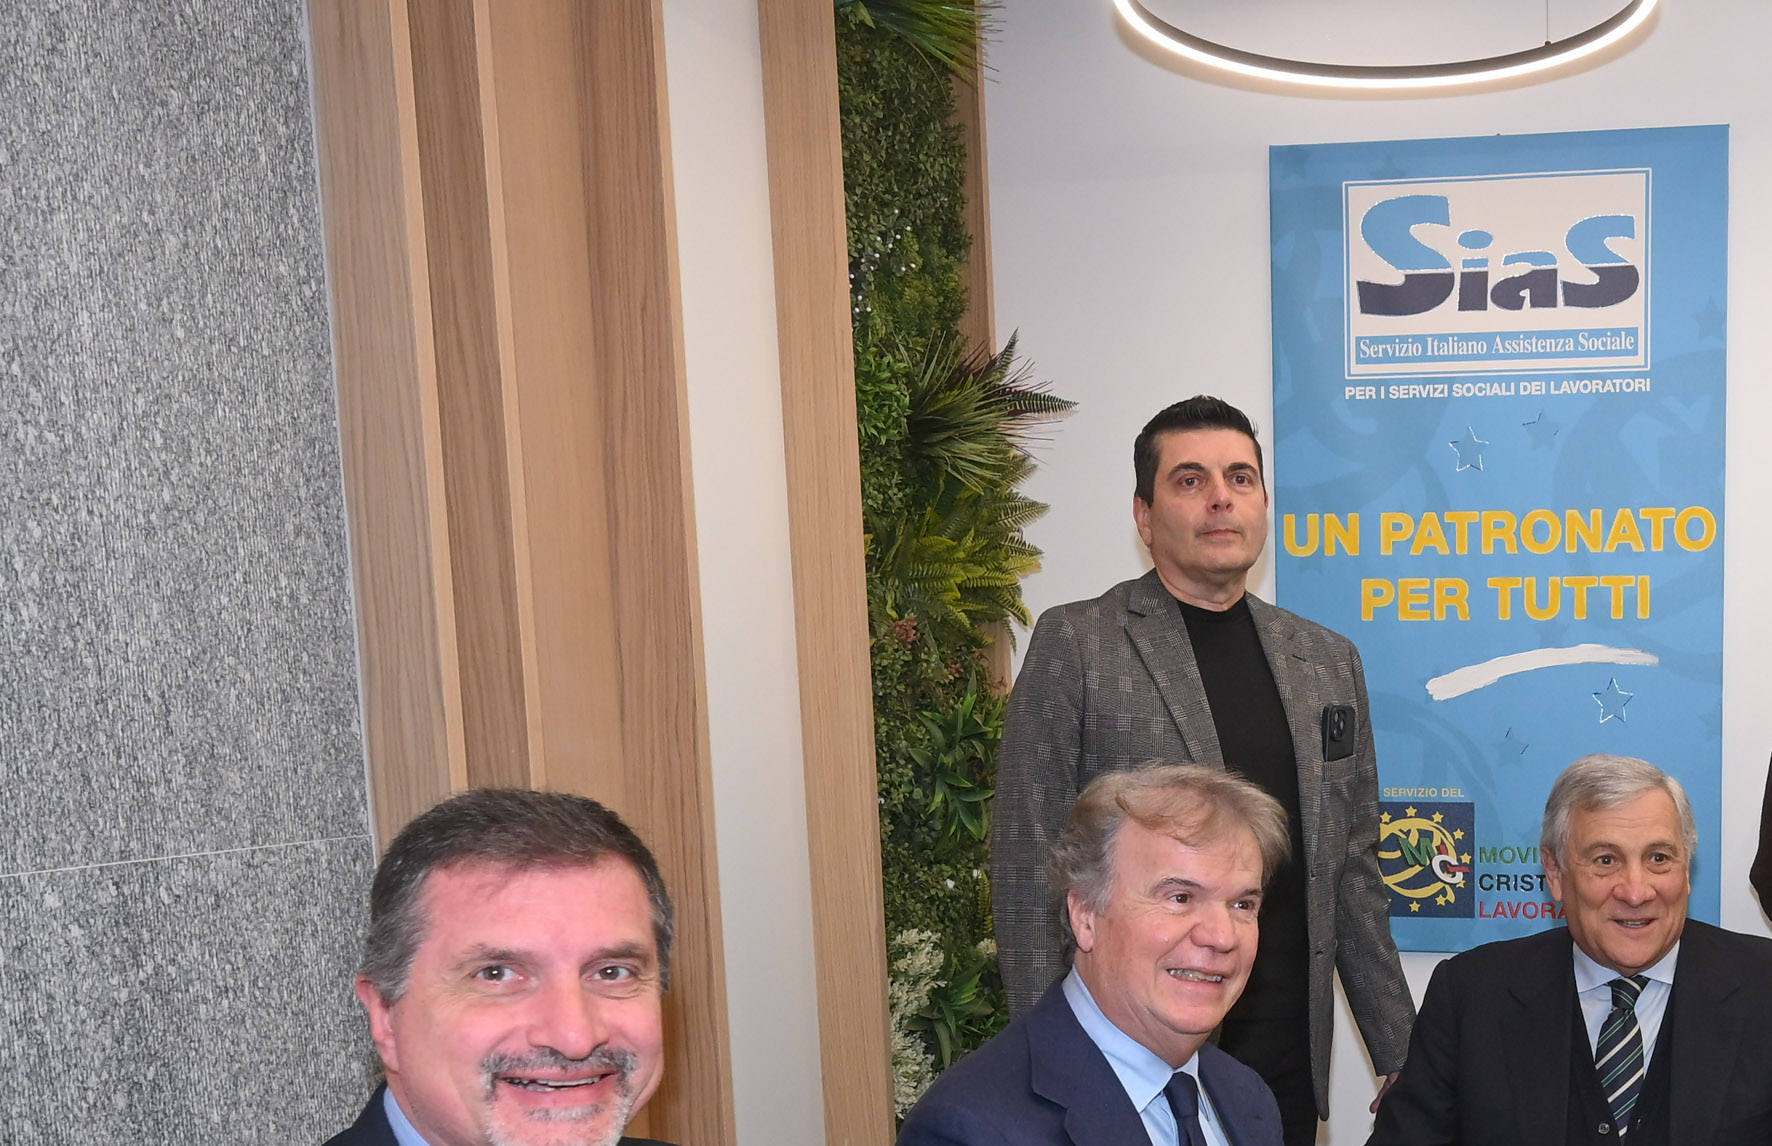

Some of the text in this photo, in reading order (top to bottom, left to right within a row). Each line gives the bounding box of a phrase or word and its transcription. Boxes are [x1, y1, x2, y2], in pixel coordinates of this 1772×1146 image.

[1360, 331, 1635, 358] Servizio Italiano Assistenza Sociale
[1345, 378, 1651, 400] PER I SERVIZI SOCIALI DEI LAVORATORI
[1283, 506, 1717, 557] UN PATRONATO
[1361, 575, 1651, 621] PER TUTTI
[1383, 787, 1465, 798] SERVIZIO DEL
[1479, 846, 1543, 864] MOVI
